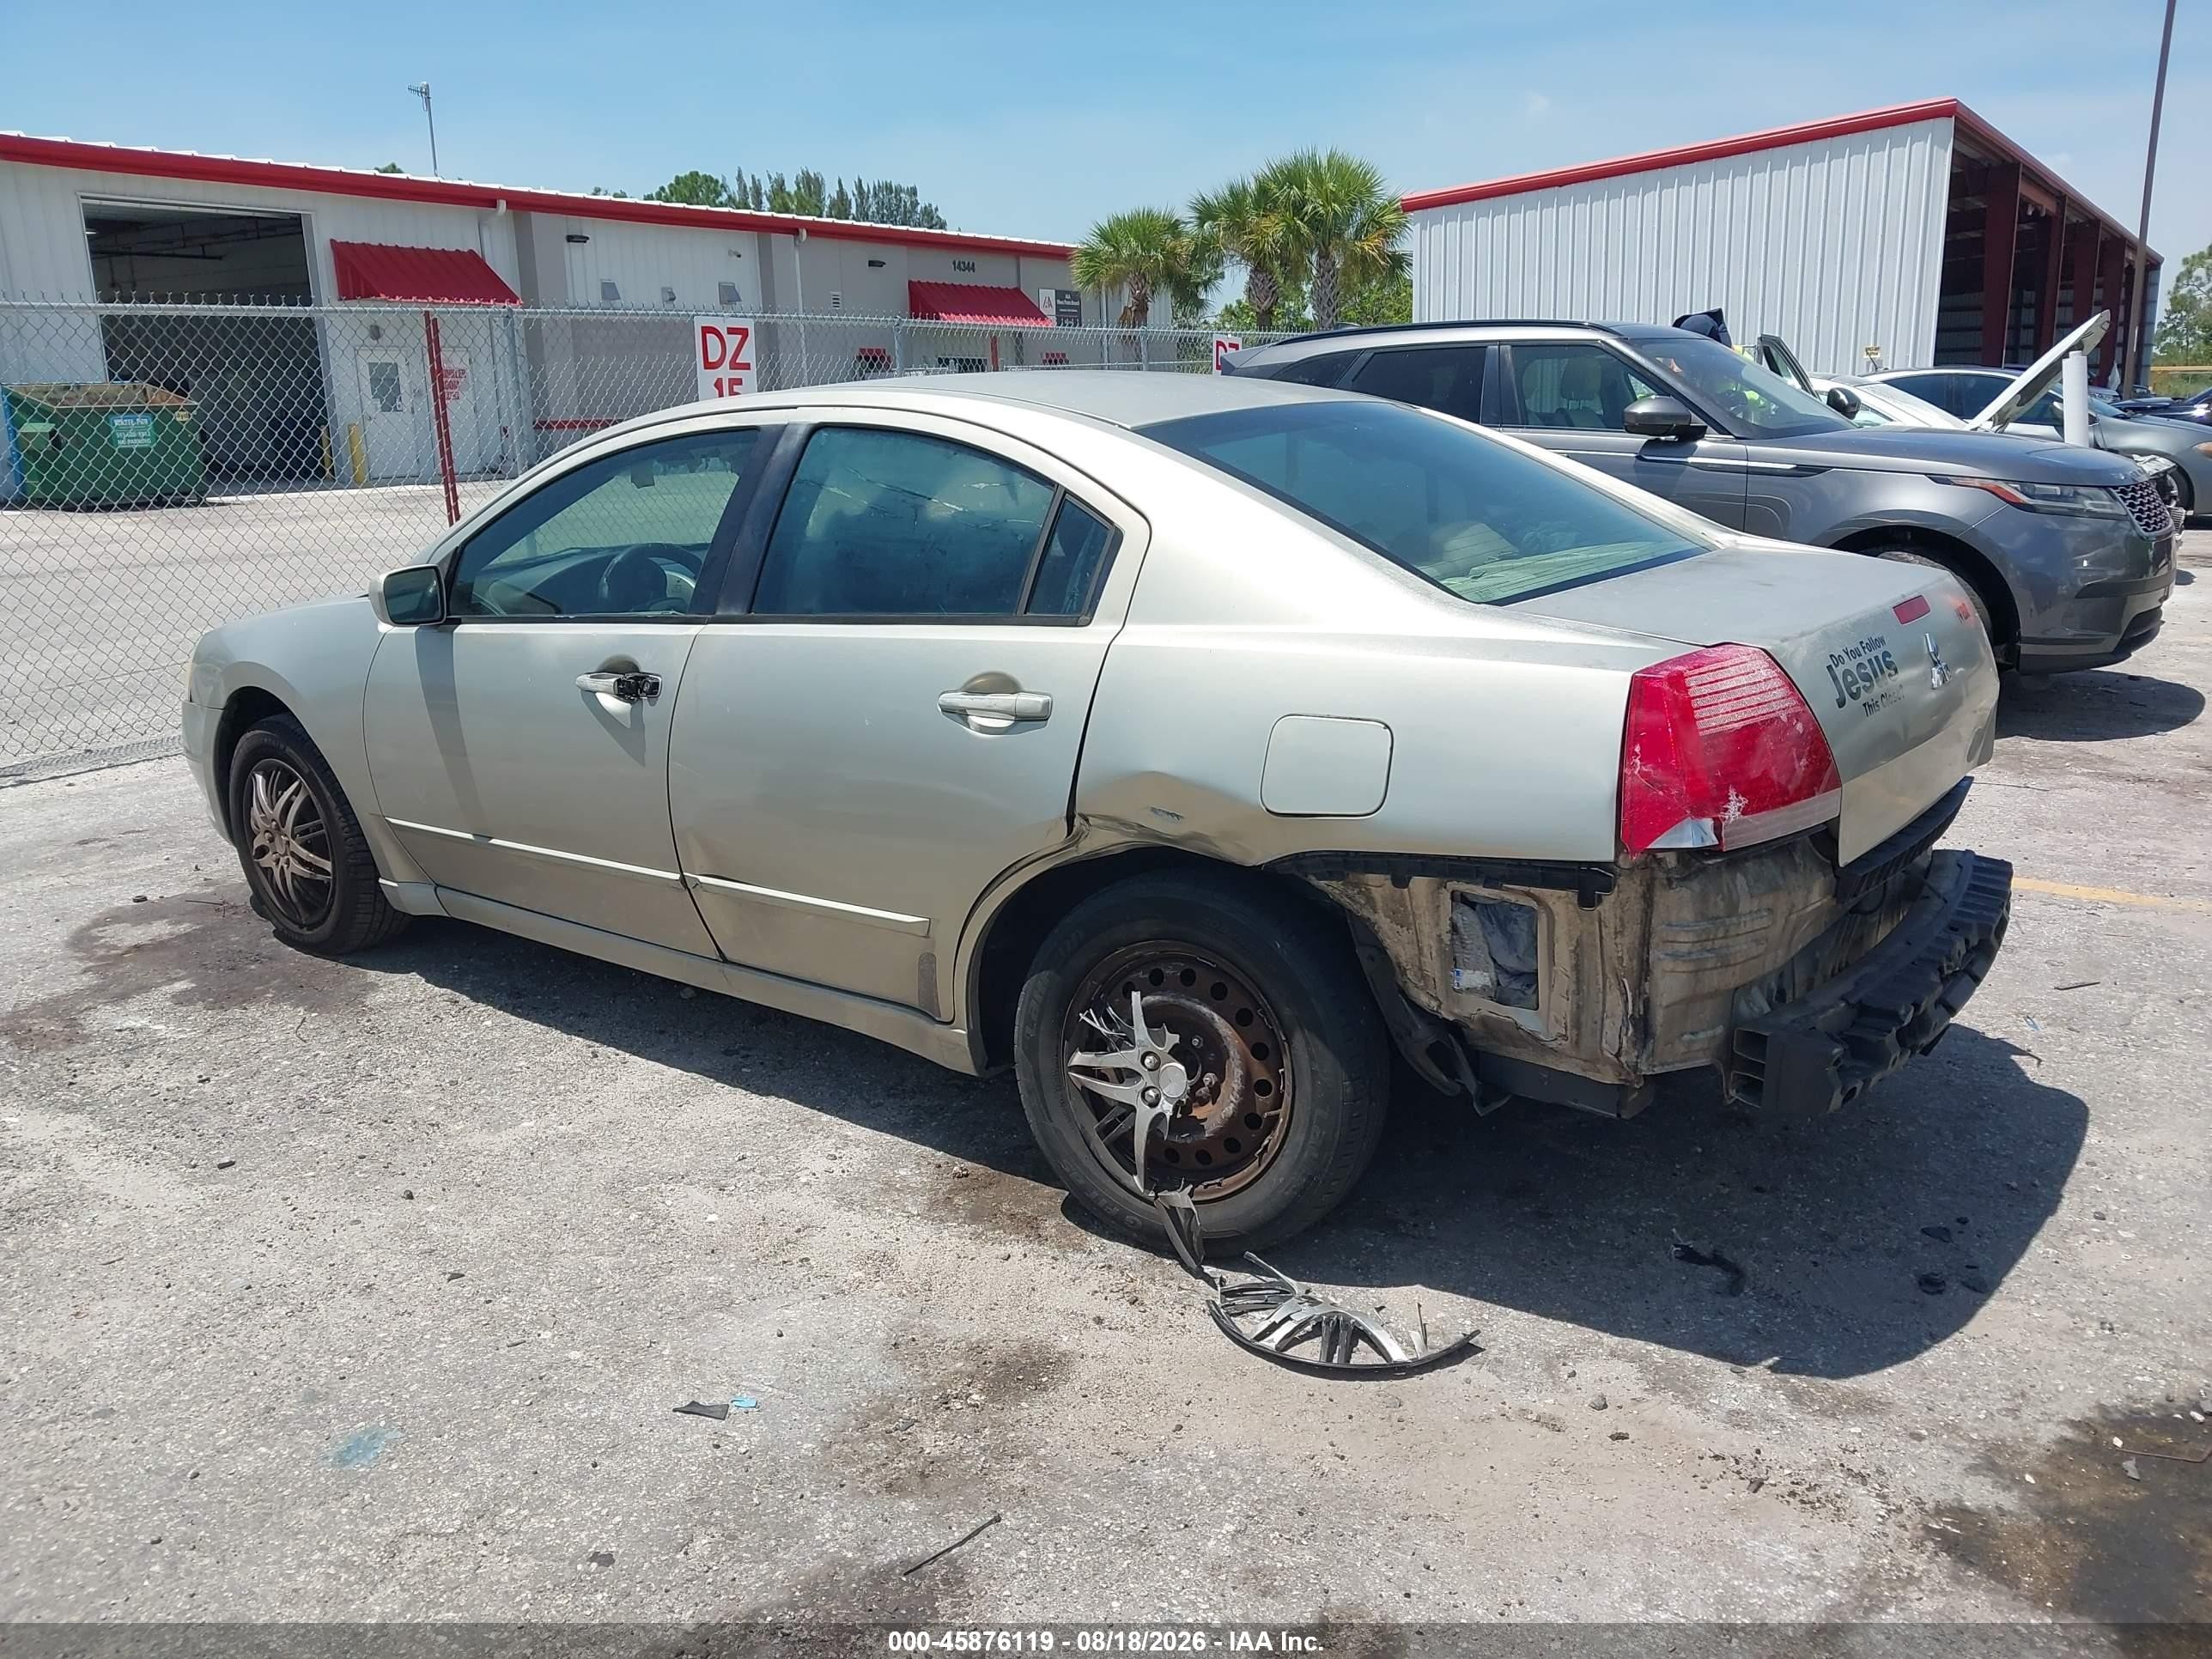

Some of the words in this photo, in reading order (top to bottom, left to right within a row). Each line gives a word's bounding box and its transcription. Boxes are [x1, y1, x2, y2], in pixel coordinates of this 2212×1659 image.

[952, 260, 975, 272] 14344
[701, 326, 751, 370] DZ
[1216, 340, 1240, 370] D
[1829, 654, 1845, 668] Do
[1842, 647, 1863, 661] You
[1859, 635, 1887, 654] Follow
[1826, 650, 1899, 708] Jesus
[1863, 698, 1881, 717] This
